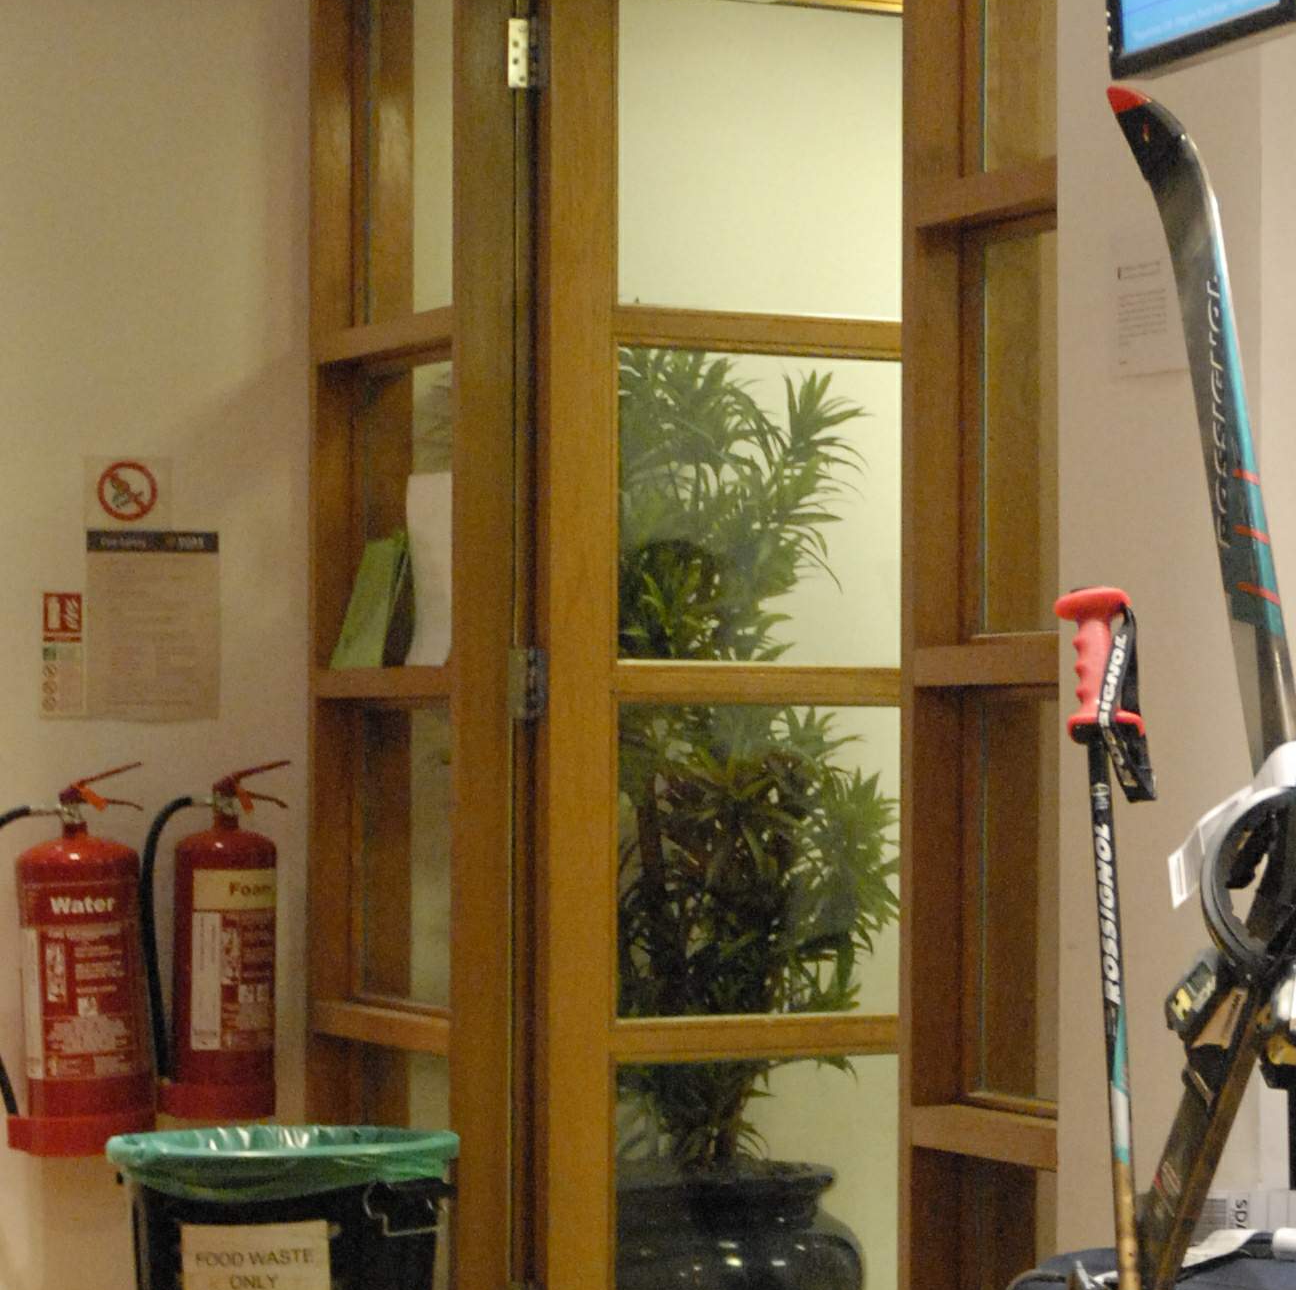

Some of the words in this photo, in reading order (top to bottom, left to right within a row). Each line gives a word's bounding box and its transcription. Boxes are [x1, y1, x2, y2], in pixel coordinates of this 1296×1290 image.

[50, 895, 117, 916] Water
[1094, 823, 1121, 1006] ROSSIGNOL
[195, 1251, 245, 1268] FOOD
[249, 1247, 313, 1266] WASTE
[229, 1273, 279, 1290] ONLY
